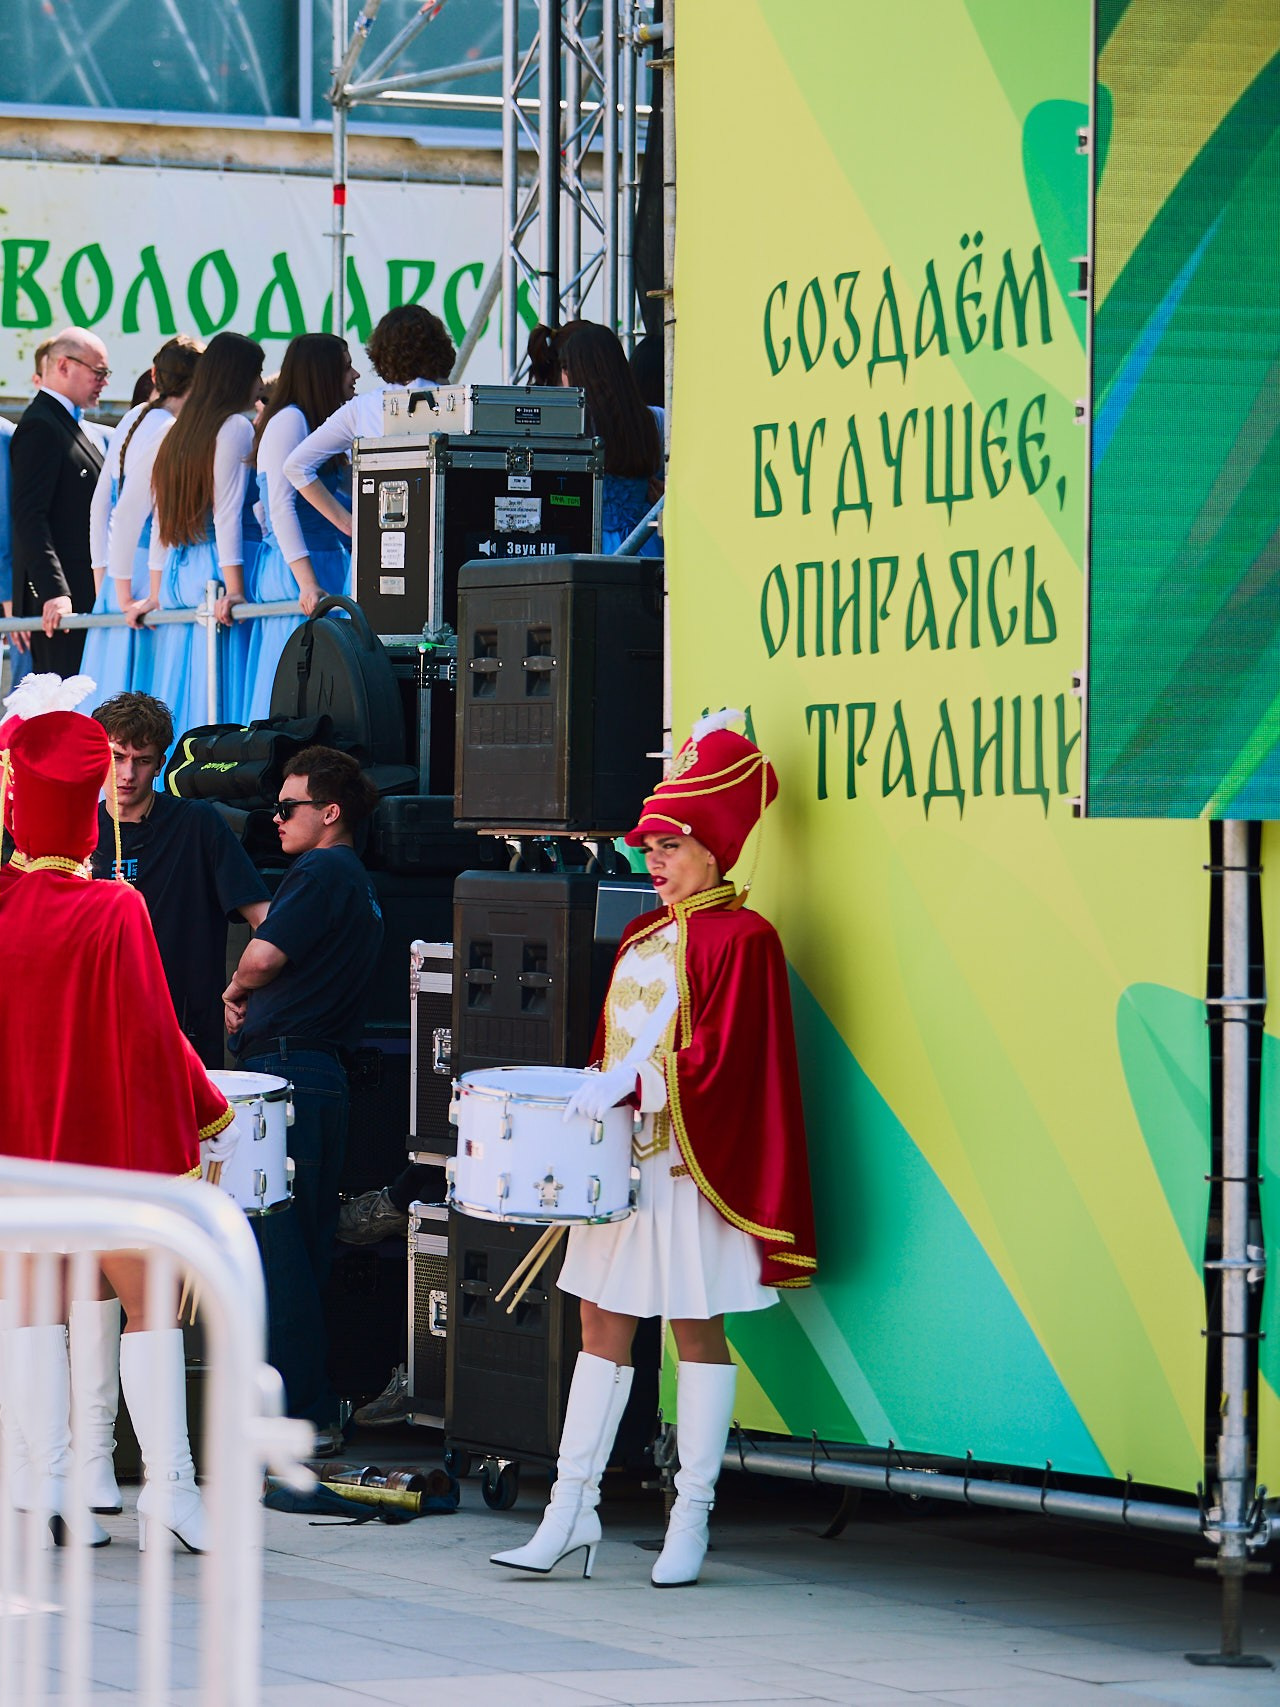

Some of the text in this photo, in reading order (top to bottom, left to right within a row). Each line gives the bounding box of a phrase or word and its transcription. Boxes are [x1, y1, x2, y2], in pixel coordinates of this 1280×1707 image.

[763, 230, 1053, 389] СОЗДАЁМ
[753, 393, 1067, 536] БУДУЩЕЕ,
[506, 541, 556, 555] Звук НН
[760, 545, 1058, 659] ОПИРАЯСЬ
[805, 693, 1082, 821] ТРАДИЦИ
